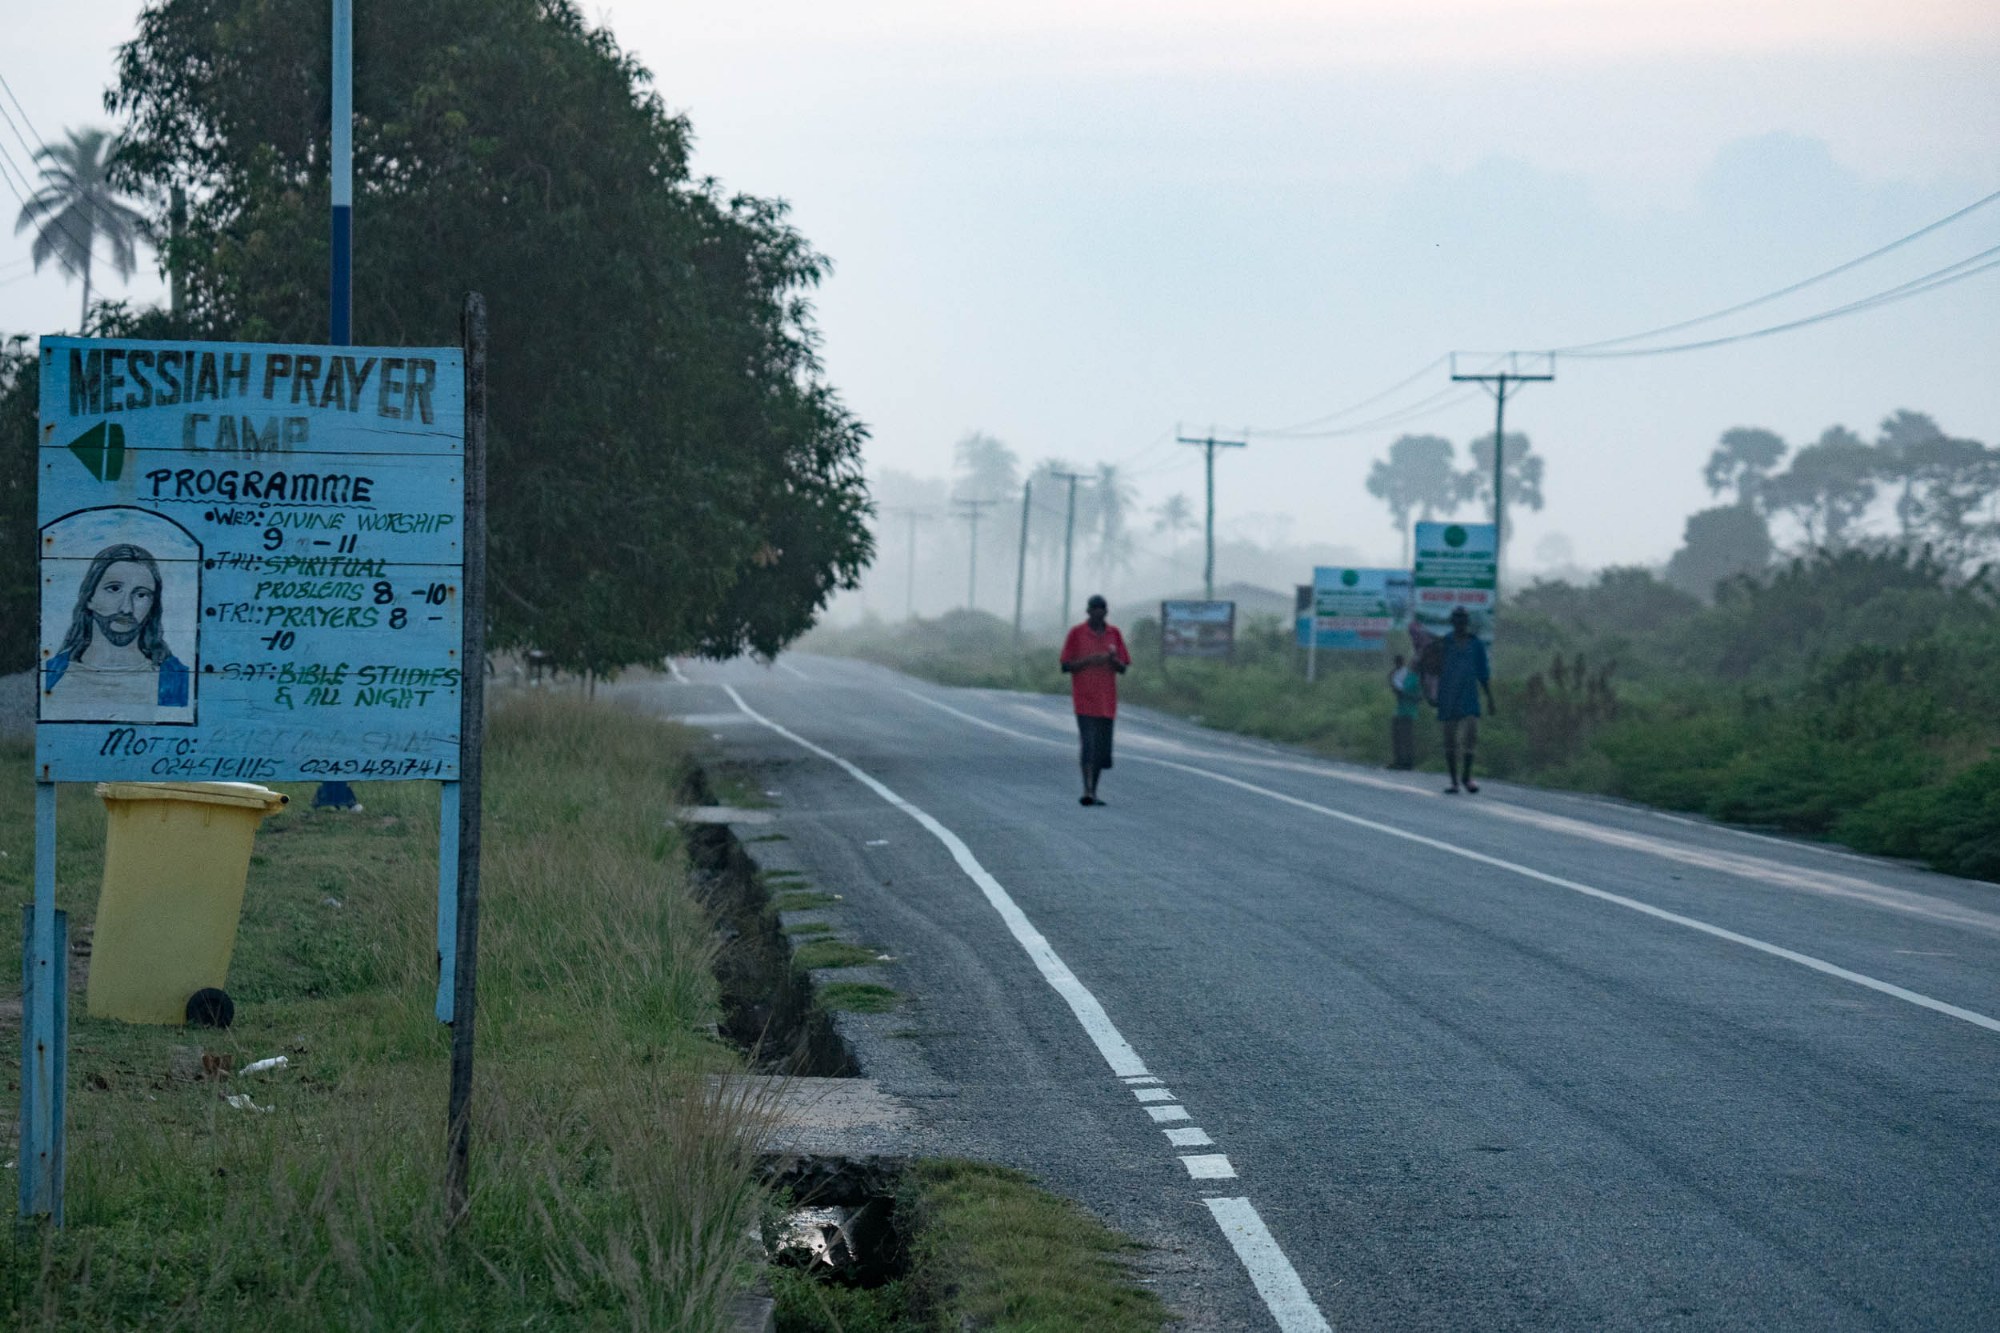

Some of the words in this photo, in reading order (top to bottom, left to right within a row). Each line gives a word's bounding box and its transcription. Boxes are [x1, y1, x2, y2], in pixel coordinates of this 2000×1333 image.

[69, 347, 252, 416] MESSIAH
[263, 353, 437, 425] PRAYER
[183, 413, 310, 458] CAMP
[146, 467, 375, 502] PROGRAMME
[266, 511, 346, 530] DIVINE
[357, 512, 454, 533] WORSHIP
[263, 527, 283, 551] 9
[263, 555, 387, 578] SPIRITUAL
[254, 580, 365, 600] PROBLEMS
[373, 581, 394, 605] 8
[264, 605, 379, 628] PRAYERS
[388, 607, 408, 629] 8
[277, 662, 348, 686] BIBLE
[357, 665, 460, 687] STUDIES
[274, 687, 295, 709] &
[303, 687, 342, 707] ALL
[353, 687, 434, 709] NIGHT
